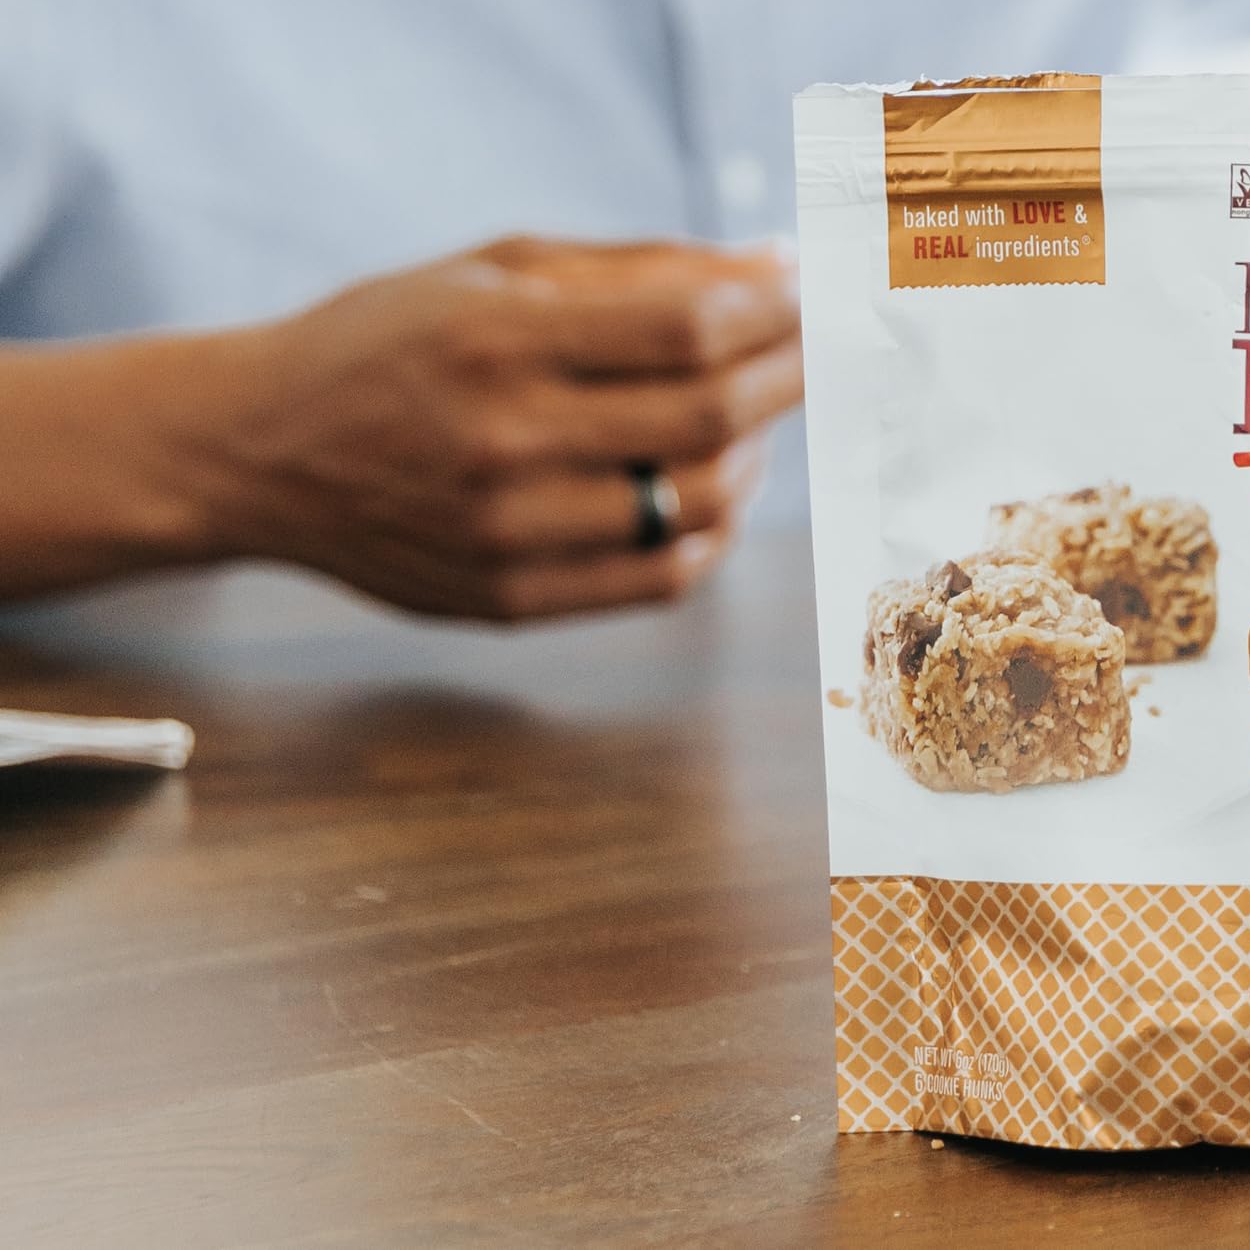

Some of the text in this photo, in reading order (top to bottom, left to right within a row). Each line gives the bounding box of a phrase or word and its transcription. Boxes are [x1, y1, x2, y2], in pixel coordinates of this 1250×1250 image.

[903, 201, 1088, 228] baked with LOVE &
[914, 235, 1080, 262] REAL ingredients
[914, 1046, 938, 1067] NET
[940, 1048, 953, 1068] WT
[977, 1053, 1010, 1078] (170g)
[915, 1072, 1003, 1102] 6 COOKIE HUNKS
